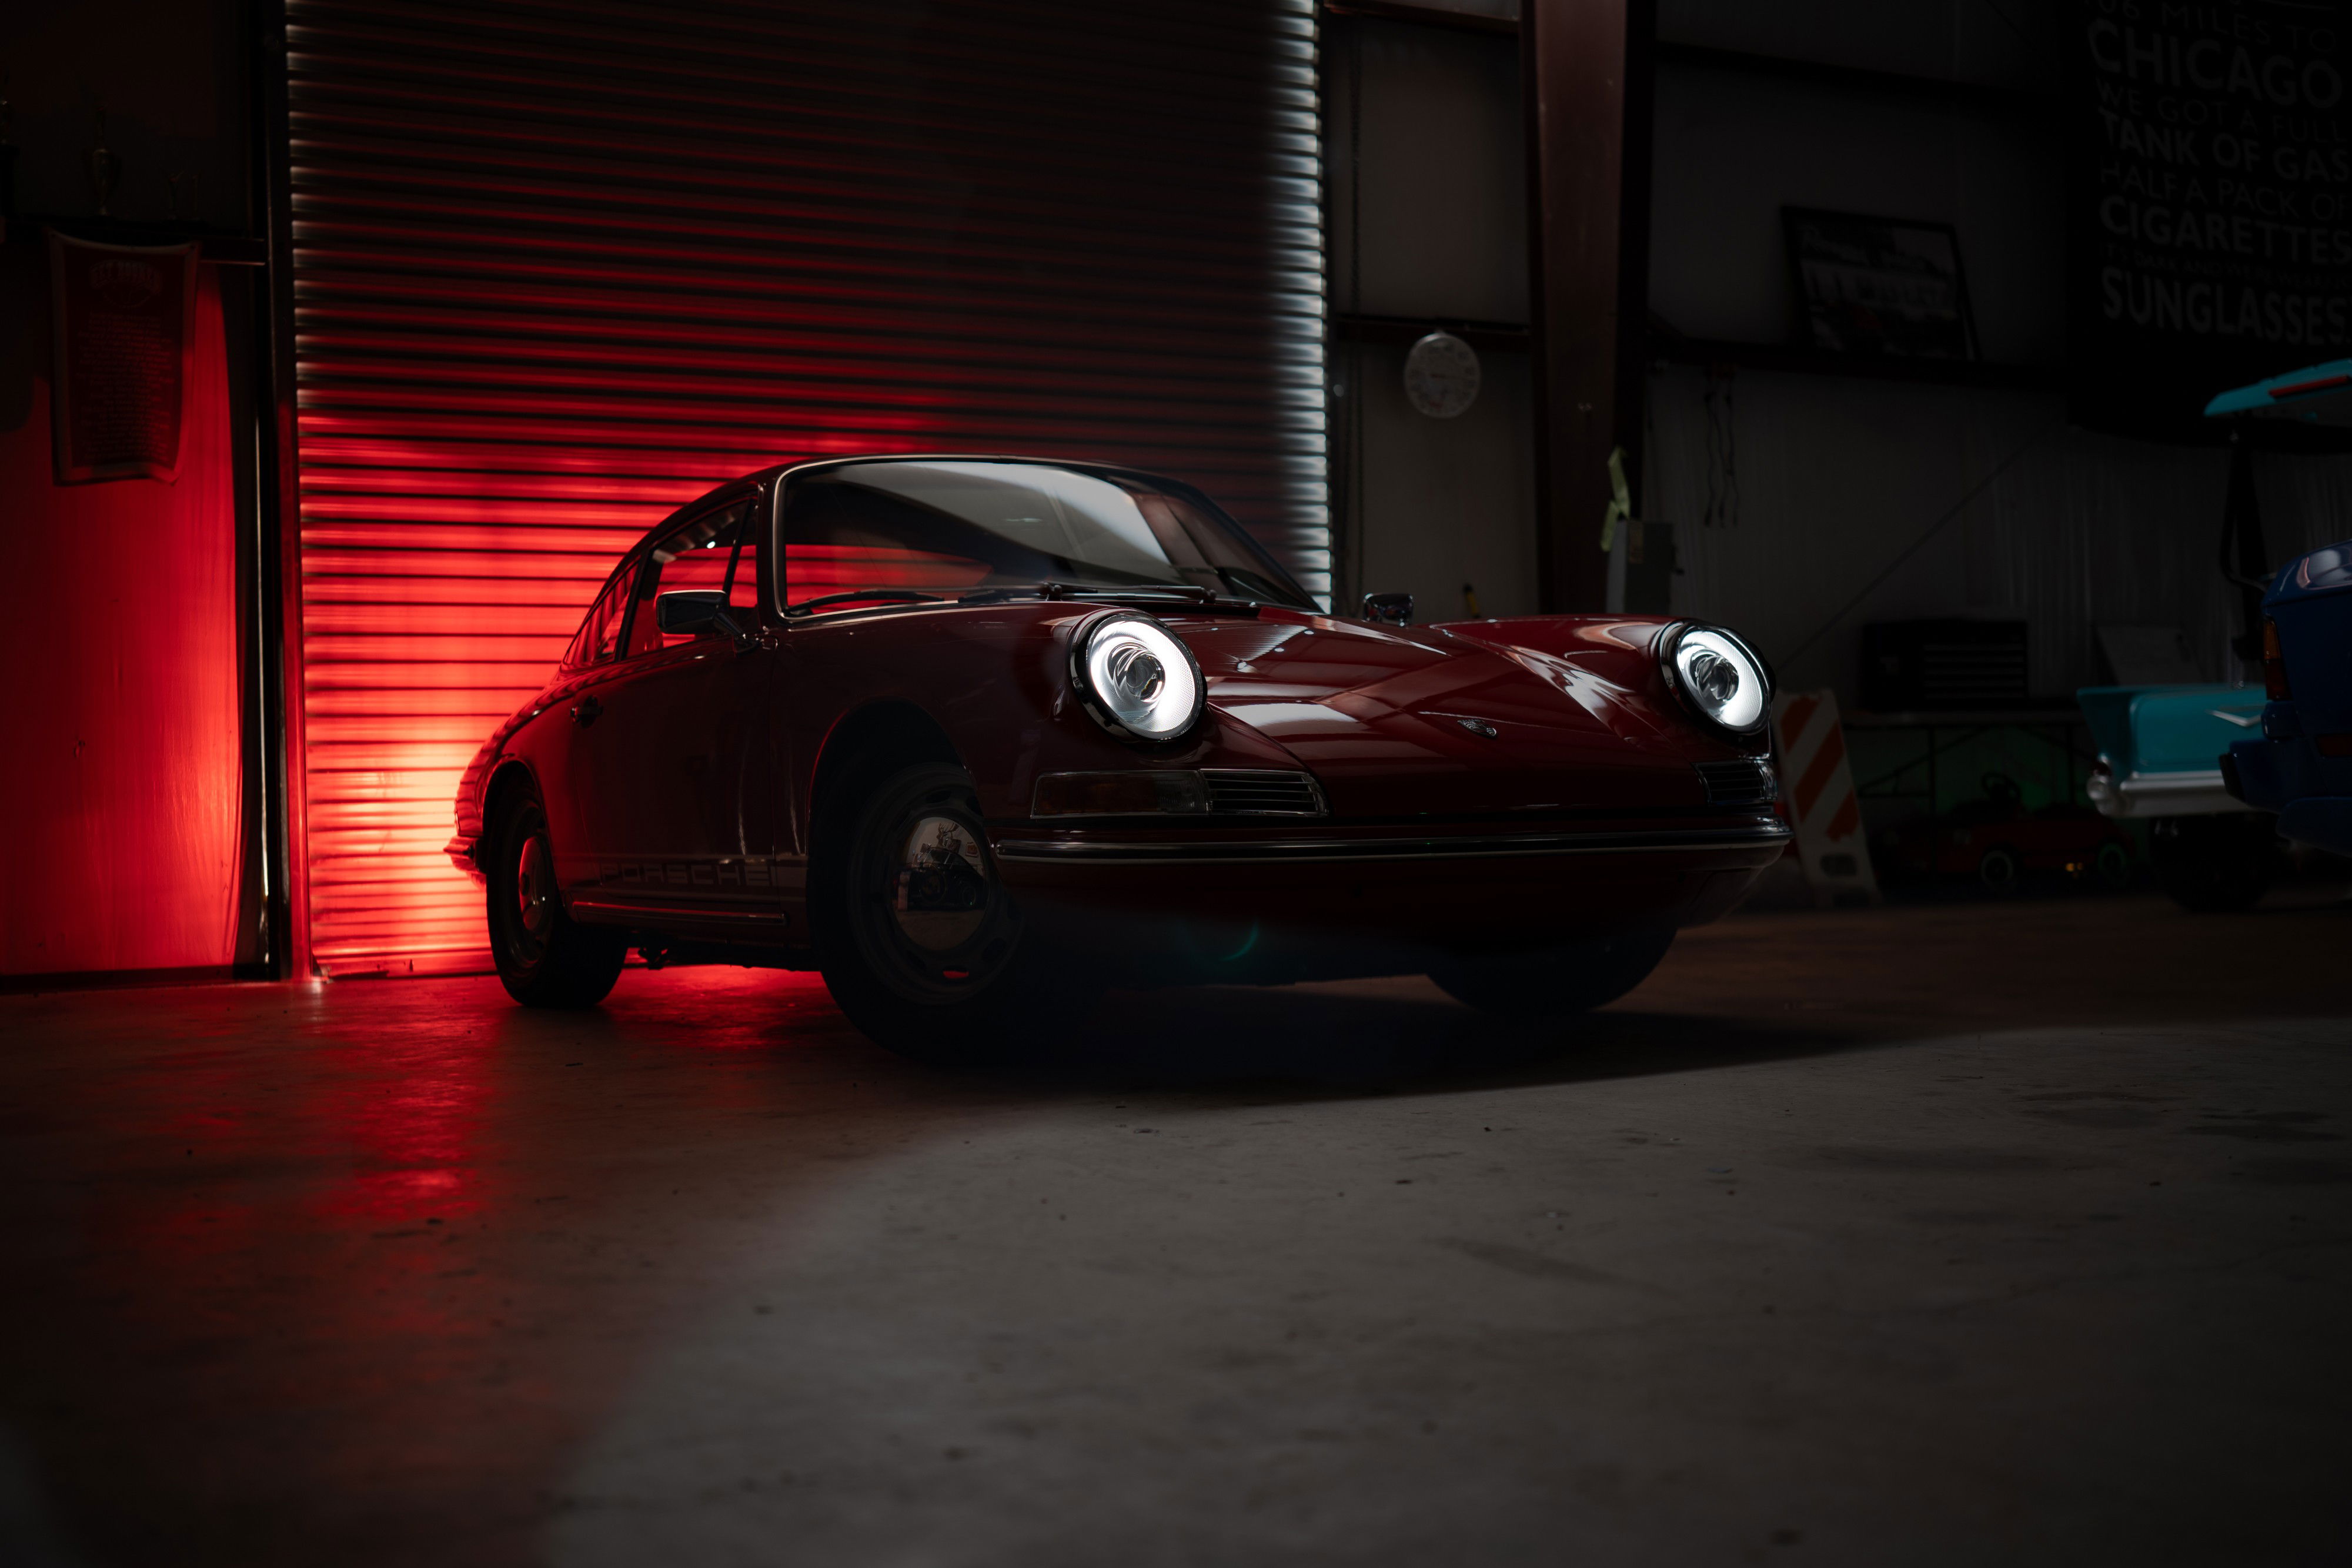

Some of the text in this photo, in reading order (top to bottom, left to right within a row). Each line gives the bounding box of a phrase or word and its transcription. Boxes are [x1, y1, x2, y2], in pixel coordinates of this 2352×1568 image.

[2085, 0, 2337, 52] 06 MILES TO
[2087, 17, 2343, 109] CHICAGO
[2095, 75, 2347, 143] WE GOT A FULL
[2097, 105, 2350, 183] TANK OF GAS
[2099, 155, 2350, 222] HALF A PACK OF
[2099, 194, 2352, 266] CIGARETTES
[600, 862, 770, 886] PORSCHE
